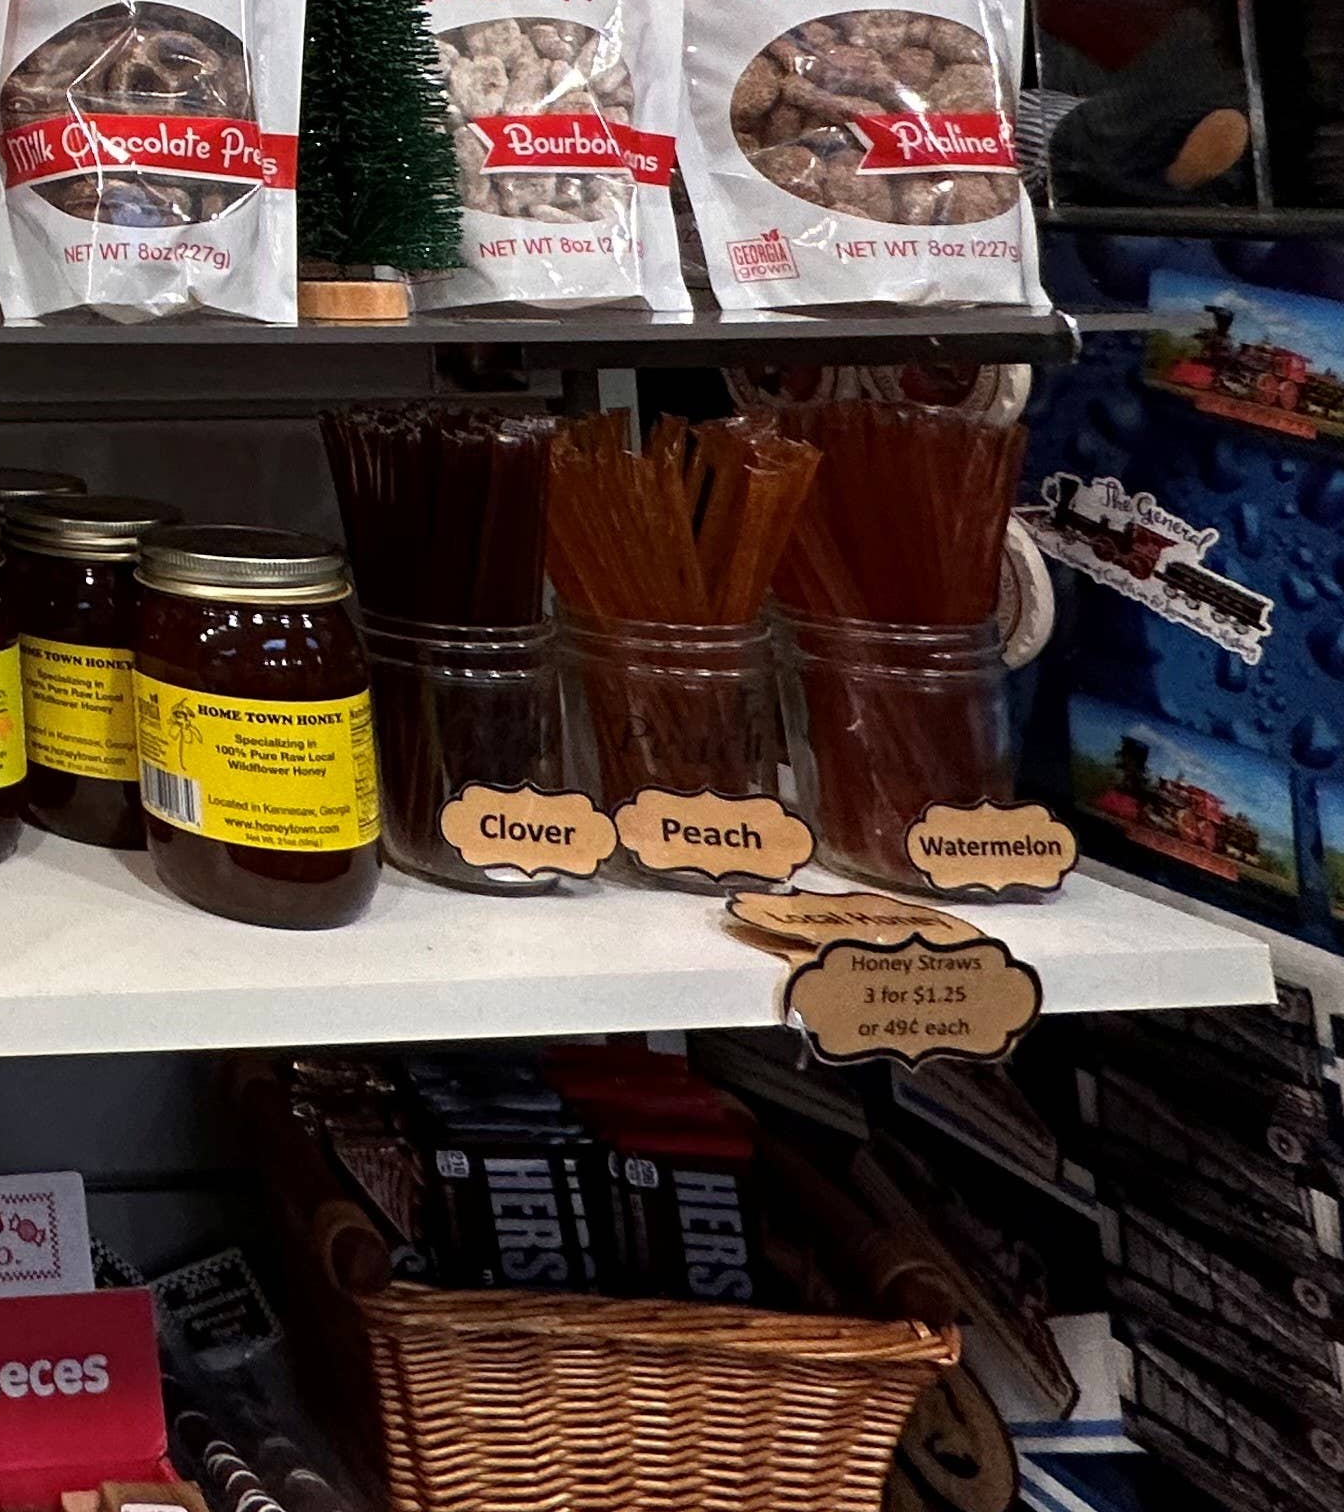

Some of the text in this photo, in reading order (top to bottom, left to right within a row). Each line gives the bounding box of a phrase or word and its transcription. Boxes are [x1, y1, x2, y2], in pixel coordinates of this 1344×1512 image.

[506, 122, 621, 159] Bourbon
[734, 242, 790, 264] GEORGIA
[740, 263, 795, 281] grown
[1136, 495, 1217, 555] General
[197, 705, 343, 725] HOME TOWN HONEY
[215, 745, 335, 761] 100% Pure Raw Local
[234, 734, 304, 751] Specializing
[227, 760, 327, 777] Wildflower Honey
[208, 794, 248, 812] Located
[251, 803, 261, 812] in
[224, 815, 339, 836] www.honeytown.com
[480, 813, 577, 847] Clover
[661, 818, 762, 850] Peach
[918, 834, 1063, 859] Watermelon
[851, 953, 982, 976] Honey Straws
[864, 984, 968, 1007] 3 for $1.25
[858, 1016, 970, 1039] or 49¢ each
